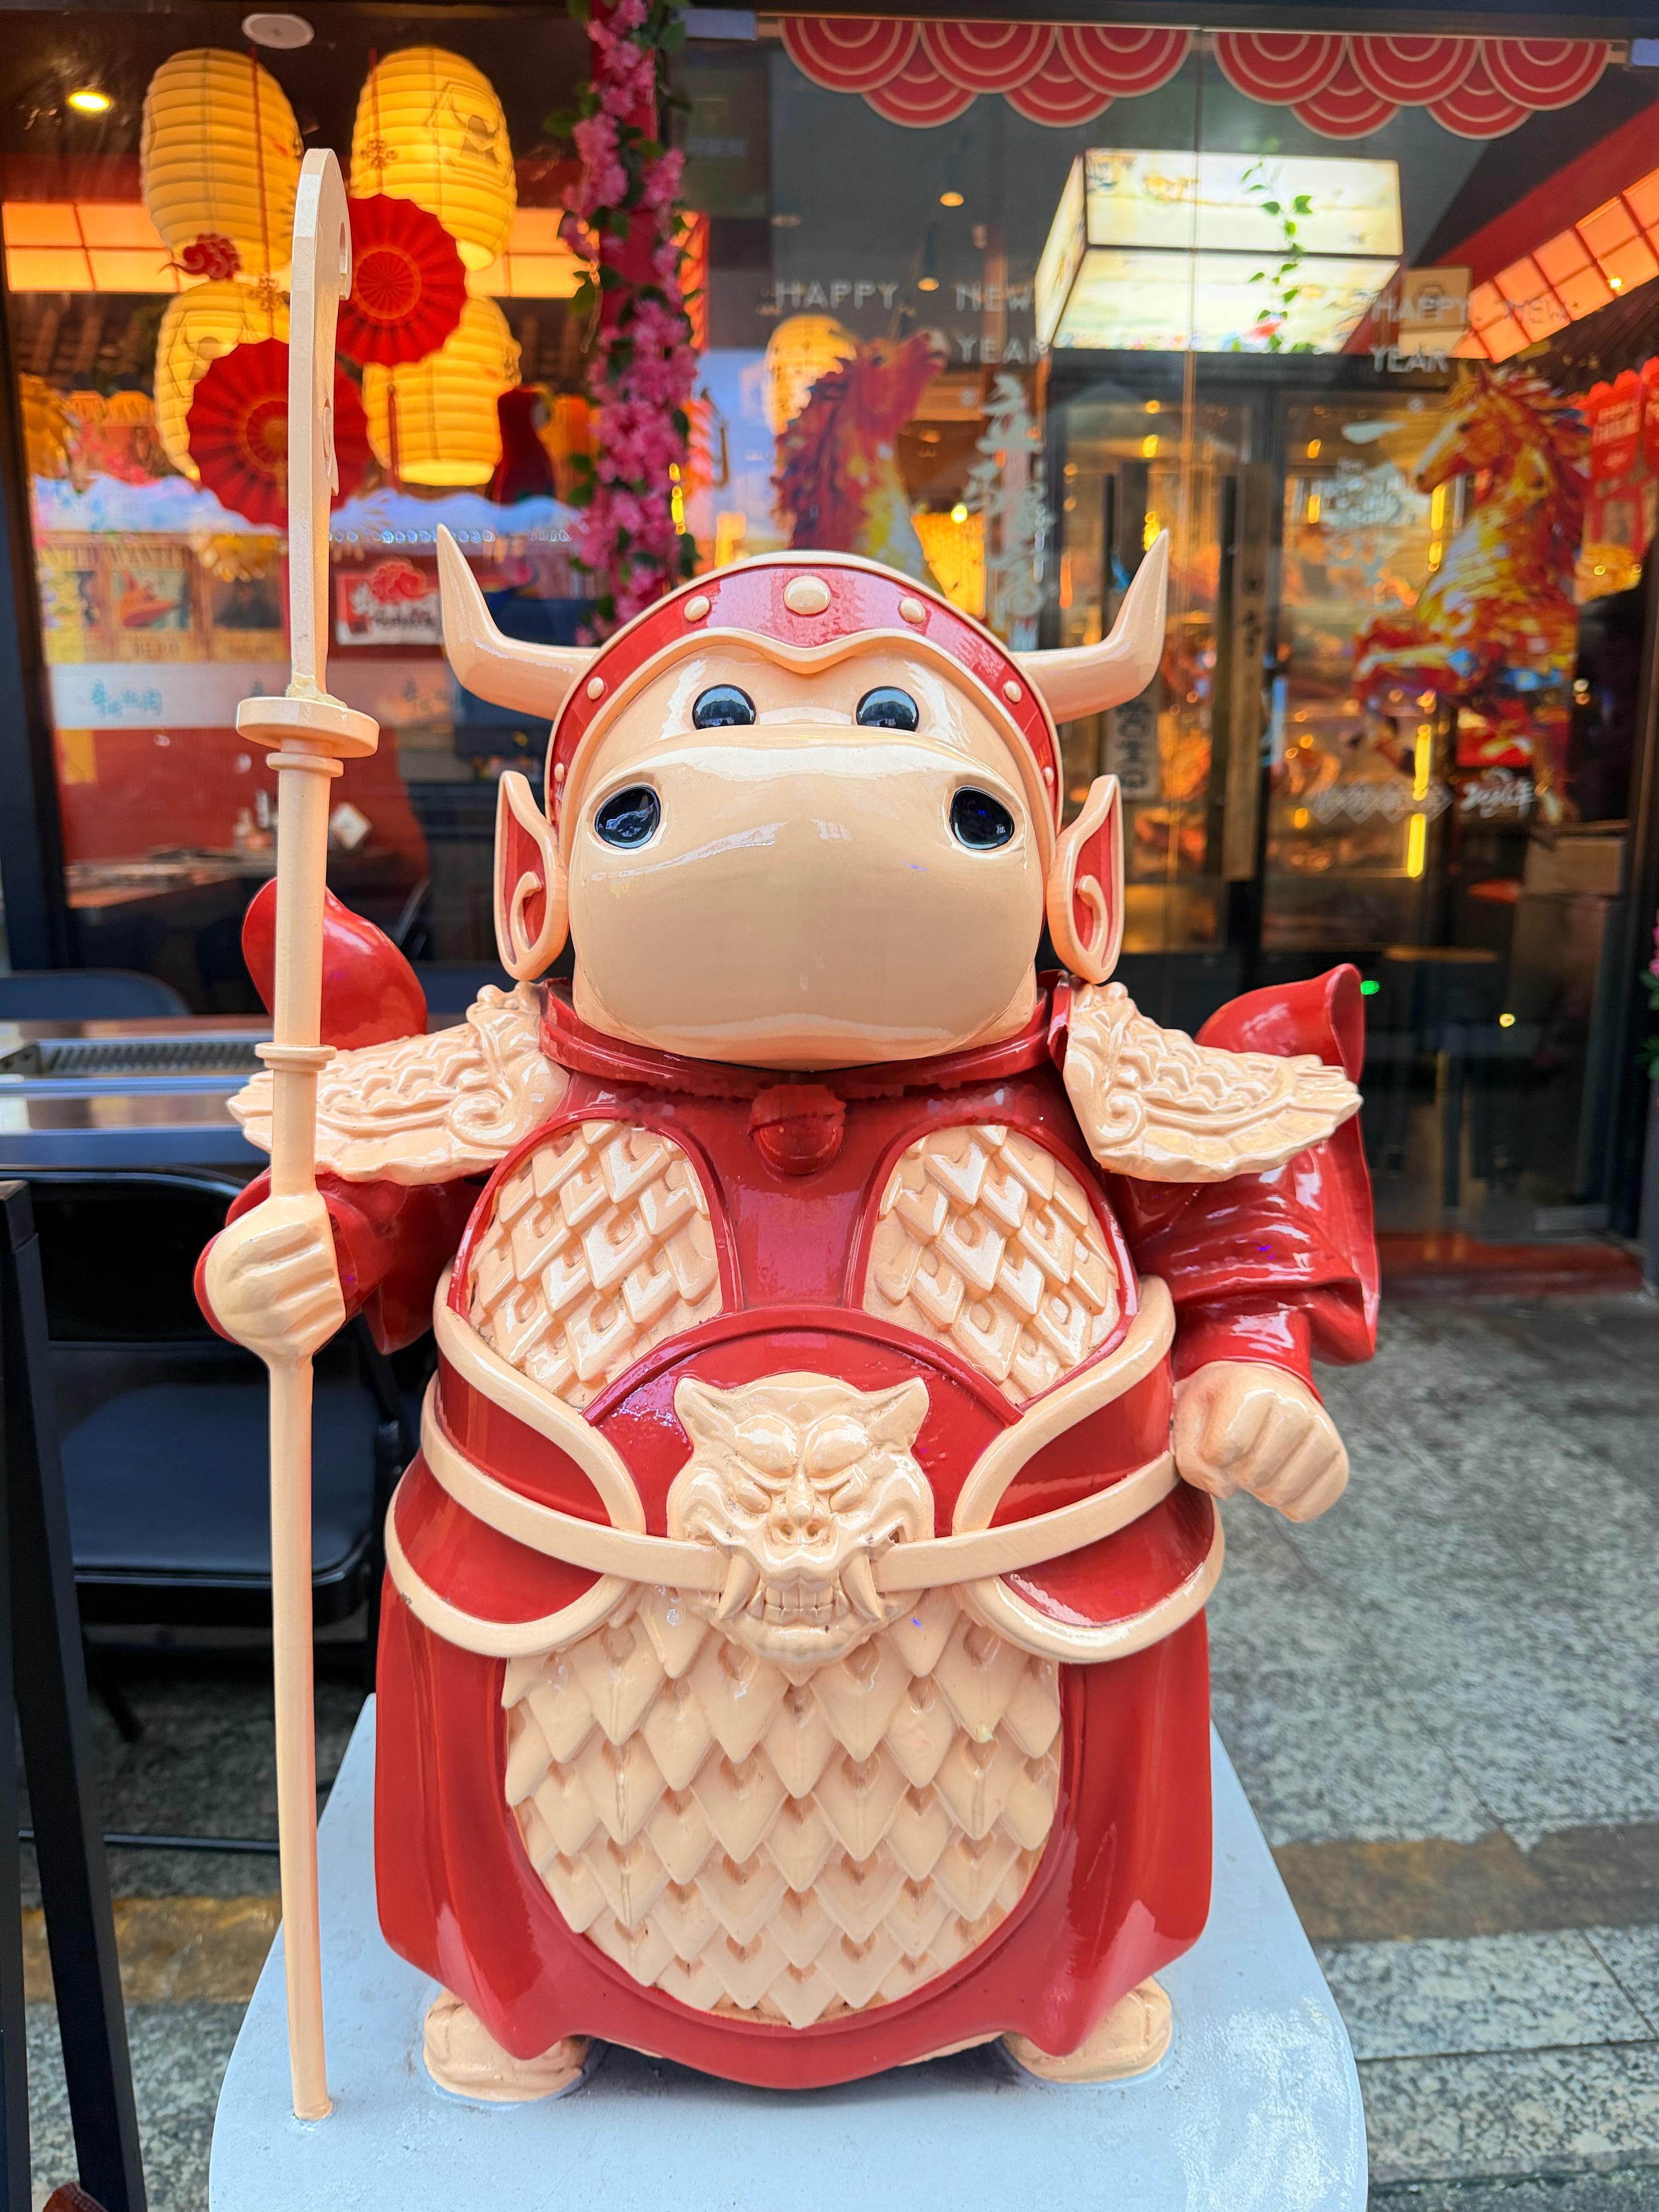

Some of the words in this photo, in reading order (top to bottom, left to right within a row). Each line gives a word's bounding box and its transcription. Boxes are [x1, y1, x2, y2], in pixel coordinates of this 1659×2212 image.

[774, 279, 900, 310] HAPPY
[955, 283, 1032, 312] NEW
[1372, 295, 1469, 325] HAPPY
[1369, 345, 1449, 373] YEAR
